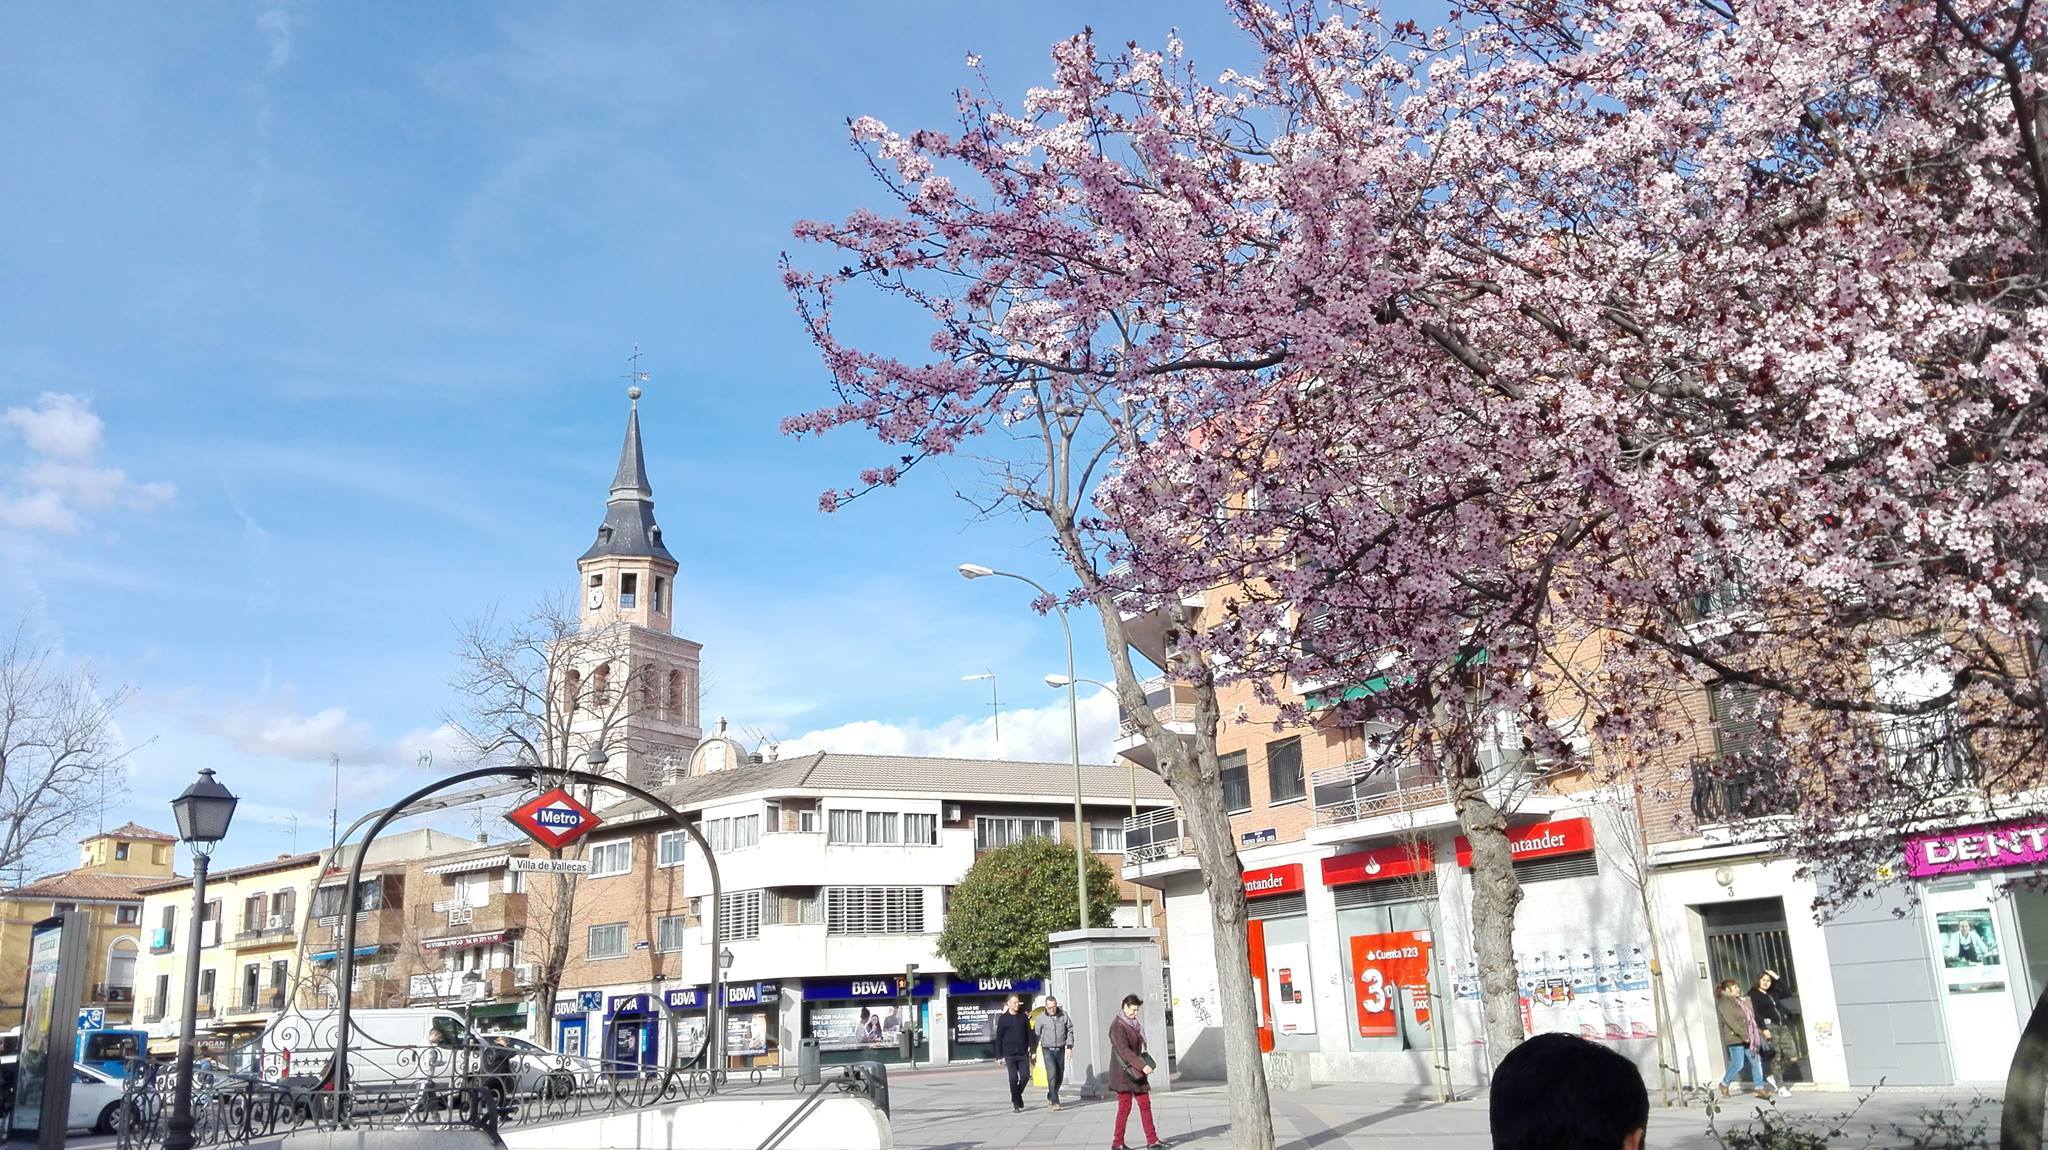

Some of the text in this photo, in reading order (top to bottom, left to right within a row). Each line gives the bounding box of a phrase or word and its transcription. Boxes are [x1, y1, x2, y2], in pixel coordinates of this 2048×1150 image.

[541, 811, 577, 825] Metro
[1511, 831, 1566, 853] ntander
[517, 860, 587, 872] Villa de Vallecas
[1727, 886, 1735, 898] 3
[1376, 947, 1419, 960] Cuenta 123
[852, 981, 888, 995] BBVA
[979, 978, 1012, 991] BBVA
[670, 992, 696, 1006] BBVA
[729, 987, 756, 1002] BBVA
[554, 1001, 577, 1015] BBVA
[812, 1029, 827, 1038] 163
